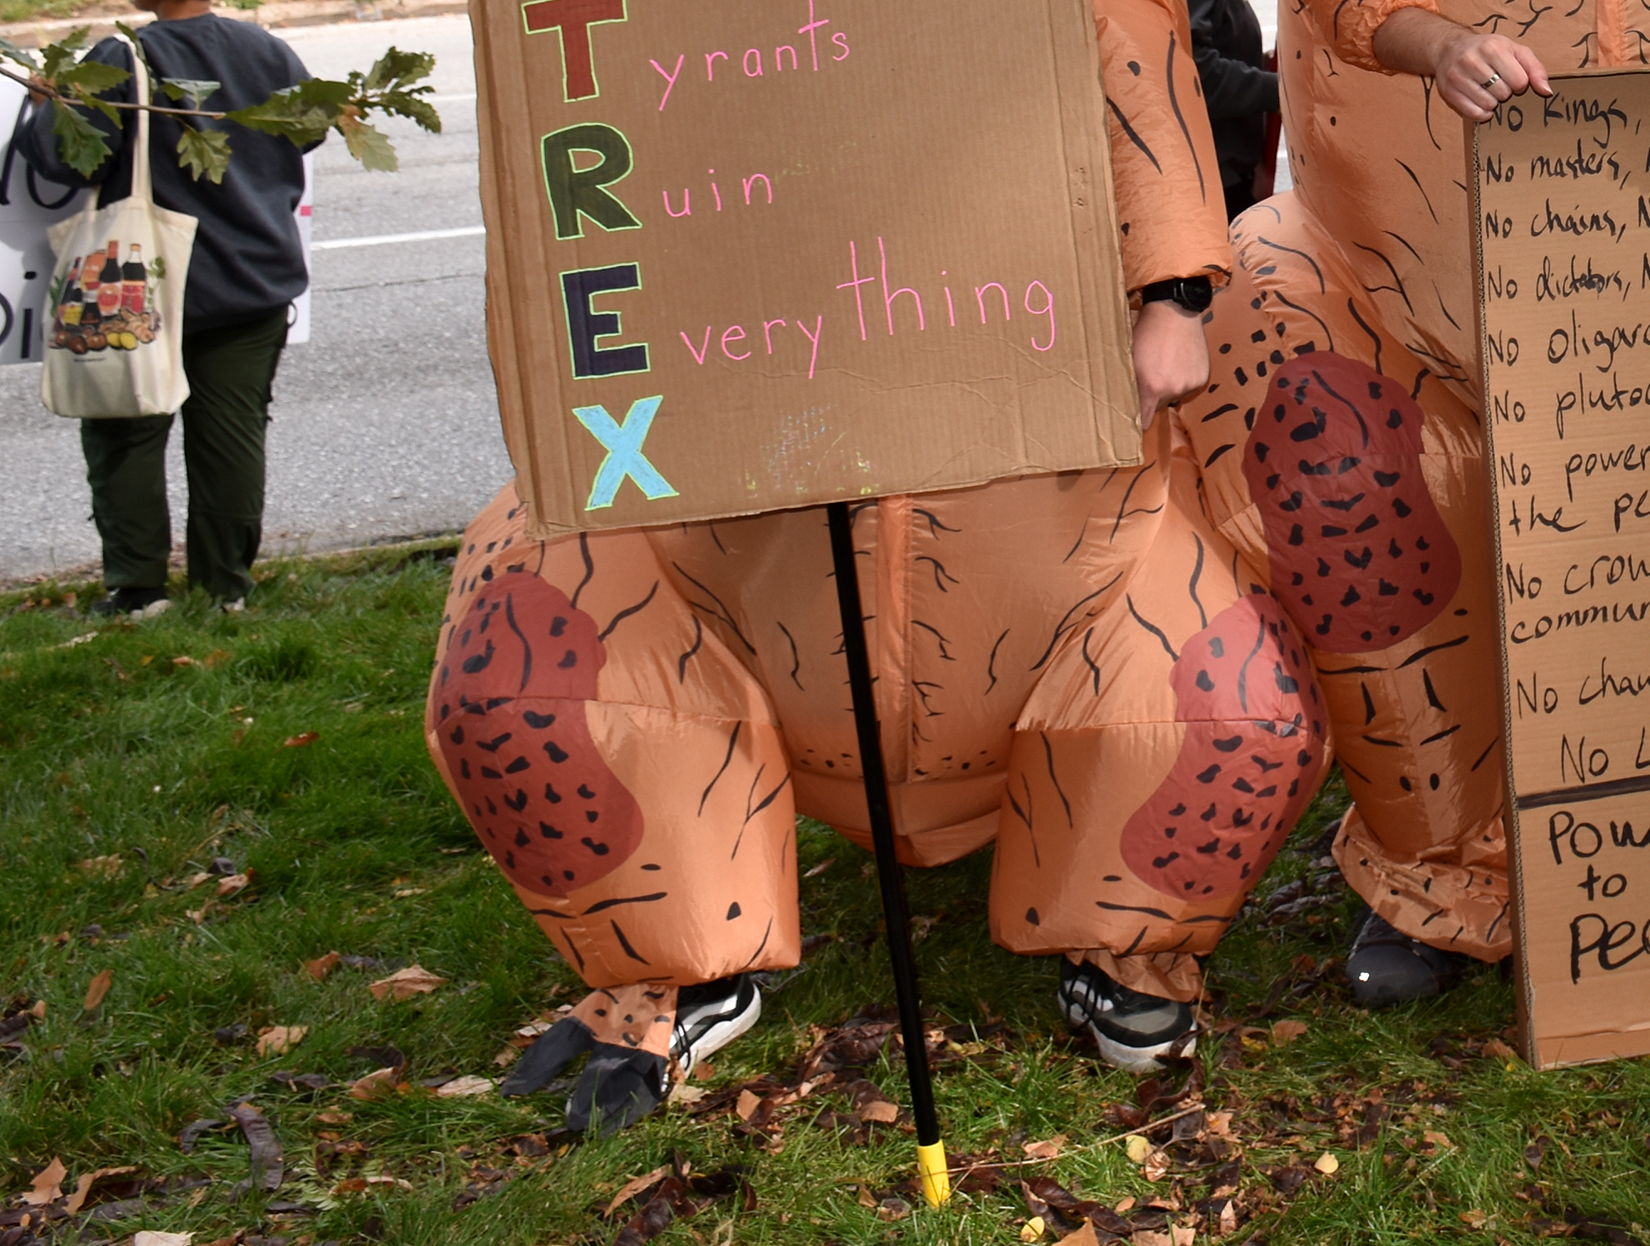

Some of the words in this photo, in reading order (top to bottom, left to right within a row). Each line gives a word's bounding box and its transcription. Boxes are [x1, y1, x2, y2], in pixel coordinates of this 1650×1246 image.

[1486, 152, 1515, 186] No
[1530, 138, 1632, 191] masters,
[1485, 209, 1513, 240] No
[1530, 197, 1627, 244] chains,
[1487, 265, 1518, 302] No
[1487, 329, 1520, 367] No
[1494, 390, 1526, 426] No
[571, 395, 680, 512] X
[1500, 454, 1532, 489] No
[1508, 495, 1588, 537] the
[1505, 562, 1542, 605] No
[1516, 671, 1559, 720] No
[1560, 733, 1609, 784] No
[1576, 863, 1628, 902] to
